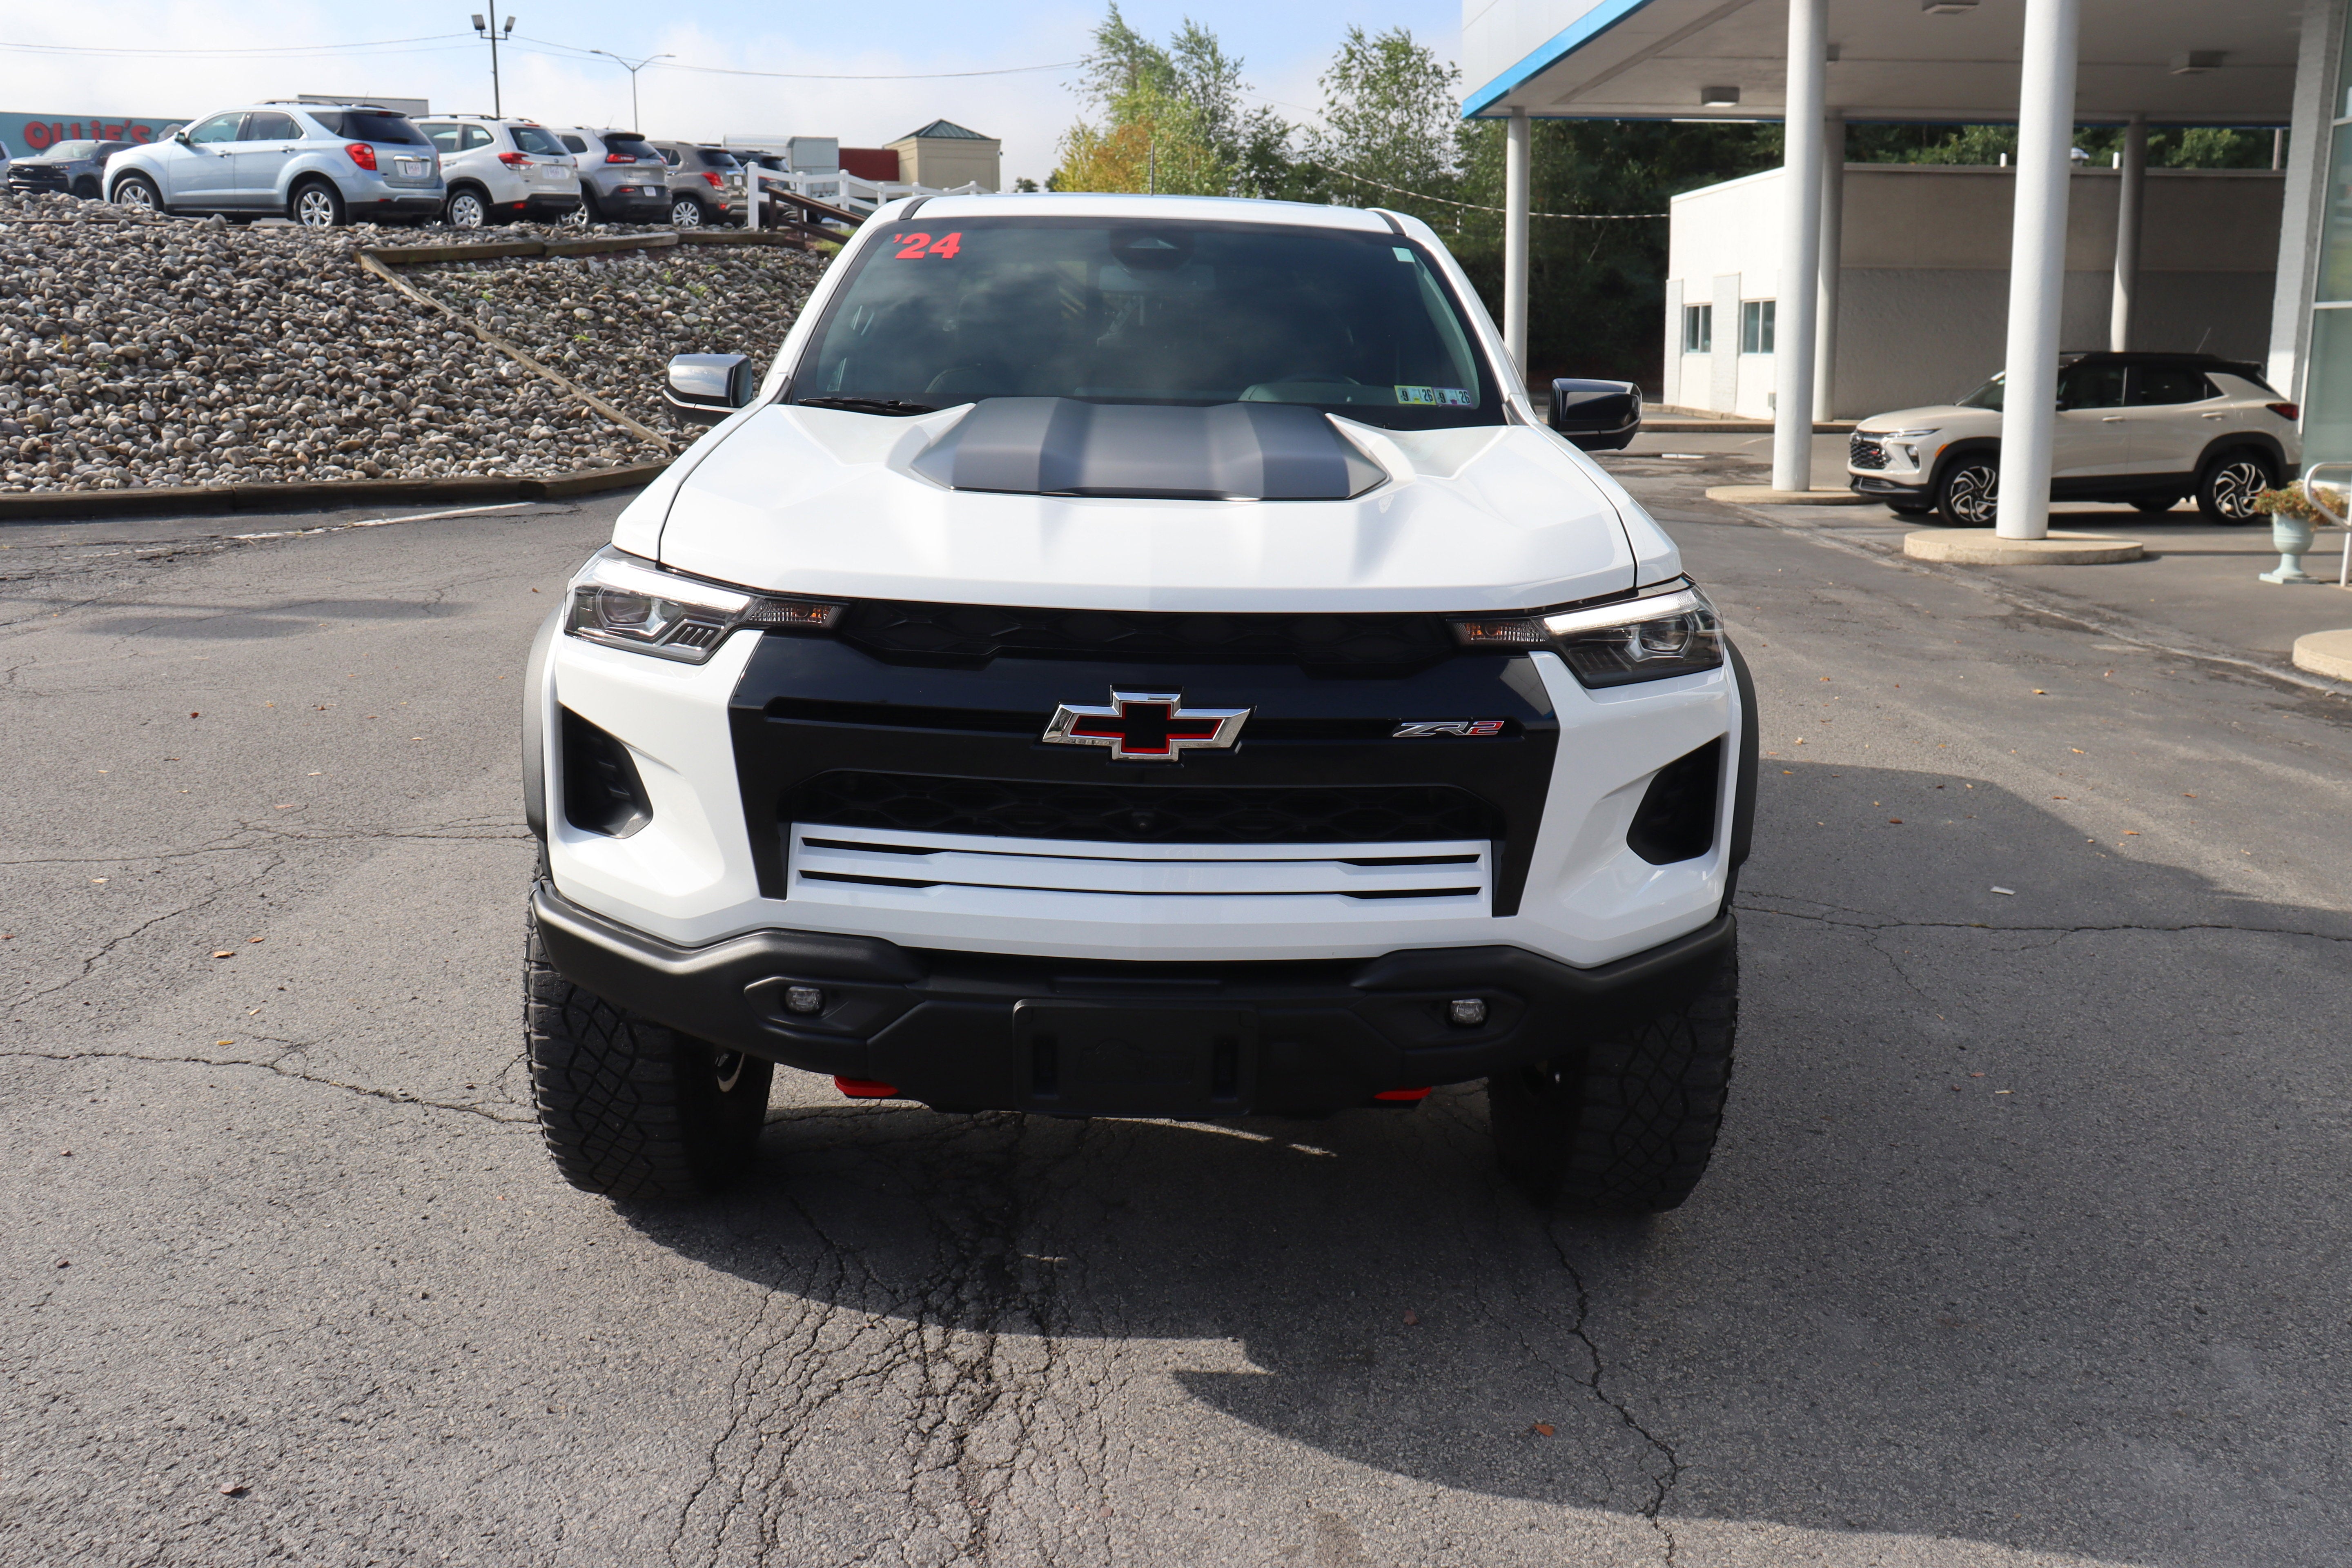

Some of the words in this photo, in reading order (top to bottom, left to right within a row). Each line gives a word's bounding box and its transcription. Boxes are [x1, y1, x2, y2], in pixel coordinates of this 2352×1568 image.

[893, 232, 962, 259] '24
[1401, 390, 1409, 401] 9
[1422, 389, 1433, 402] 26
[1439, 392, 1446, 403] 9
[1459, 391, 1470, 403] 26
[1392, 720, 1505, 737] ZR2
